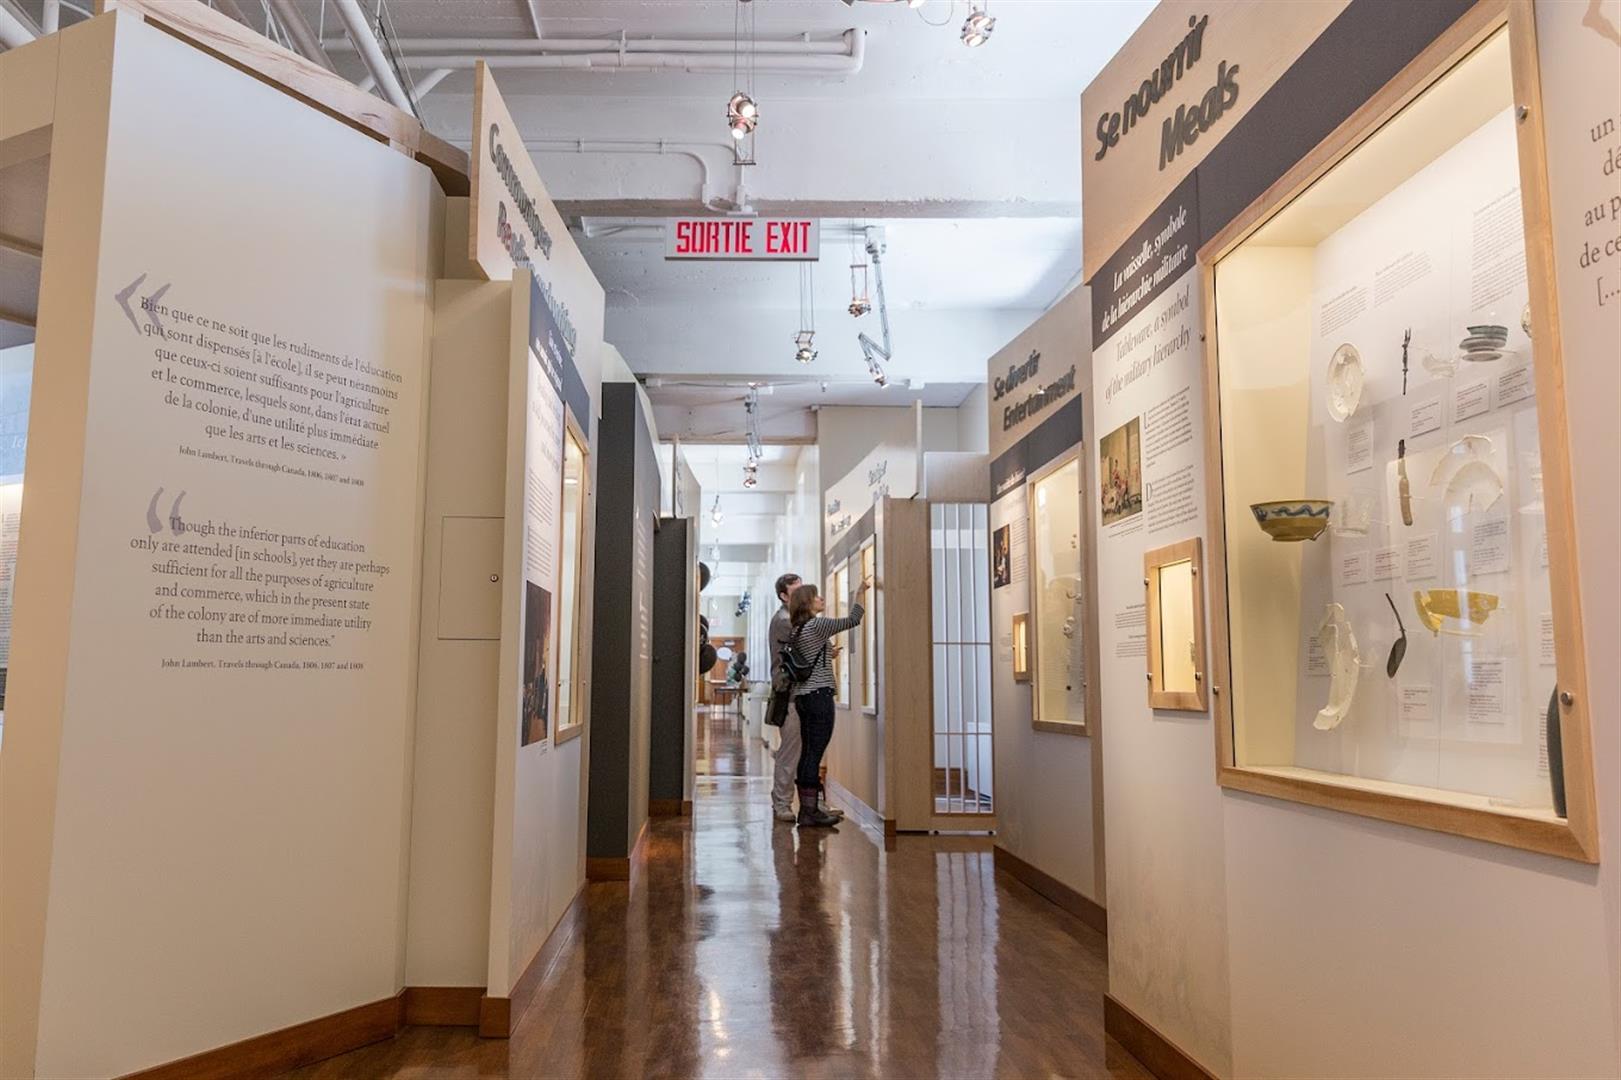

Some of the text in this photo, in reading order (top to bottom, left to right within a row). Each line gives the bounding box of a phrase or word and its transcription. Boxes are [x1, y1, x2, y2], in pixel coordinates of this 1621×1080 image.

[1095, 15, 1208, 161] Se nourrir
[1158, 60, 1239, 171] Meals
[1590, 117, 1615, 143] un
[1154, 206, 1187, 256] symbole
[1584, 203, 1606, 227] au
[676, 222, 811, 253] SORTIE EXIT
[1579, 241, 1601, 269] de
[1101, 244, 1188, 333] de la hiérarchie militaire
[1160, 284, 1190, 330] symbol
[141, 296, 402, 384] Bien que ce ne soit que les rudiments de l'éducation
[143, 323, 164, 337] qui
[167, 329, 193, 345] sont
[196, 333, 250, 360] dispensés
[305, 363, 312, 377] il
[314, 370, 324, 381] se
[326, 373, 347, 387] peut
[1153, 323, 1191, 367] hierarchy
[154, 348, 390, 416] que ceux-ci soient suffisants pour l'agriculture
[1006, 349, 1041, 393] divertir
[151, 369, 163, 381] et
[166, 367, 178, 384] le
[245, 387, 288, 409] lesquels
[315, 405, 338, 422] dans
[363, 420, 390, 434] actuel
[164, 390, 380, 450] de la colonie, d'une utilité plus immédiate
[1003, 364, 1077, 432] Entertainment
[205, 423, 226, 438] que
[229, 425, 244, 441] les
[246, 433, 266, 446] arts
[268, 437, 279, 449] et
[281, 435, 295, 451] les
[130, 535, 159, 554] only
[161, 542, 180, 553] are
[182, 542, 233, 558] attended
[299, 557, 315, 568] yet
[317, 555, 338, 571] they
[340, 561, 354, 571] are
[355, 560, 390, 577] perhaps
[169, 516, 365, 553] Though the inferior parts of education
[152, 559, 374, 592] sufficient for all the purposes of agriculture
[154, 582, 178, 597] and
[245, 588, 279, 604] which
[280, 592, 292, 605] in
[293, 592, 310, 606] the
[312, 597, 348, 610] present
[348, 600, 370, 610] state
[149, 603, 372, 632] of the colony are of more immediate utility
[196, 627, 223, 644] than
[225, 628, 244, 645] the
[245, 634, 266, 645] arts
[267, 631, 287, 645] and
[161, 658, 180, 669] John
